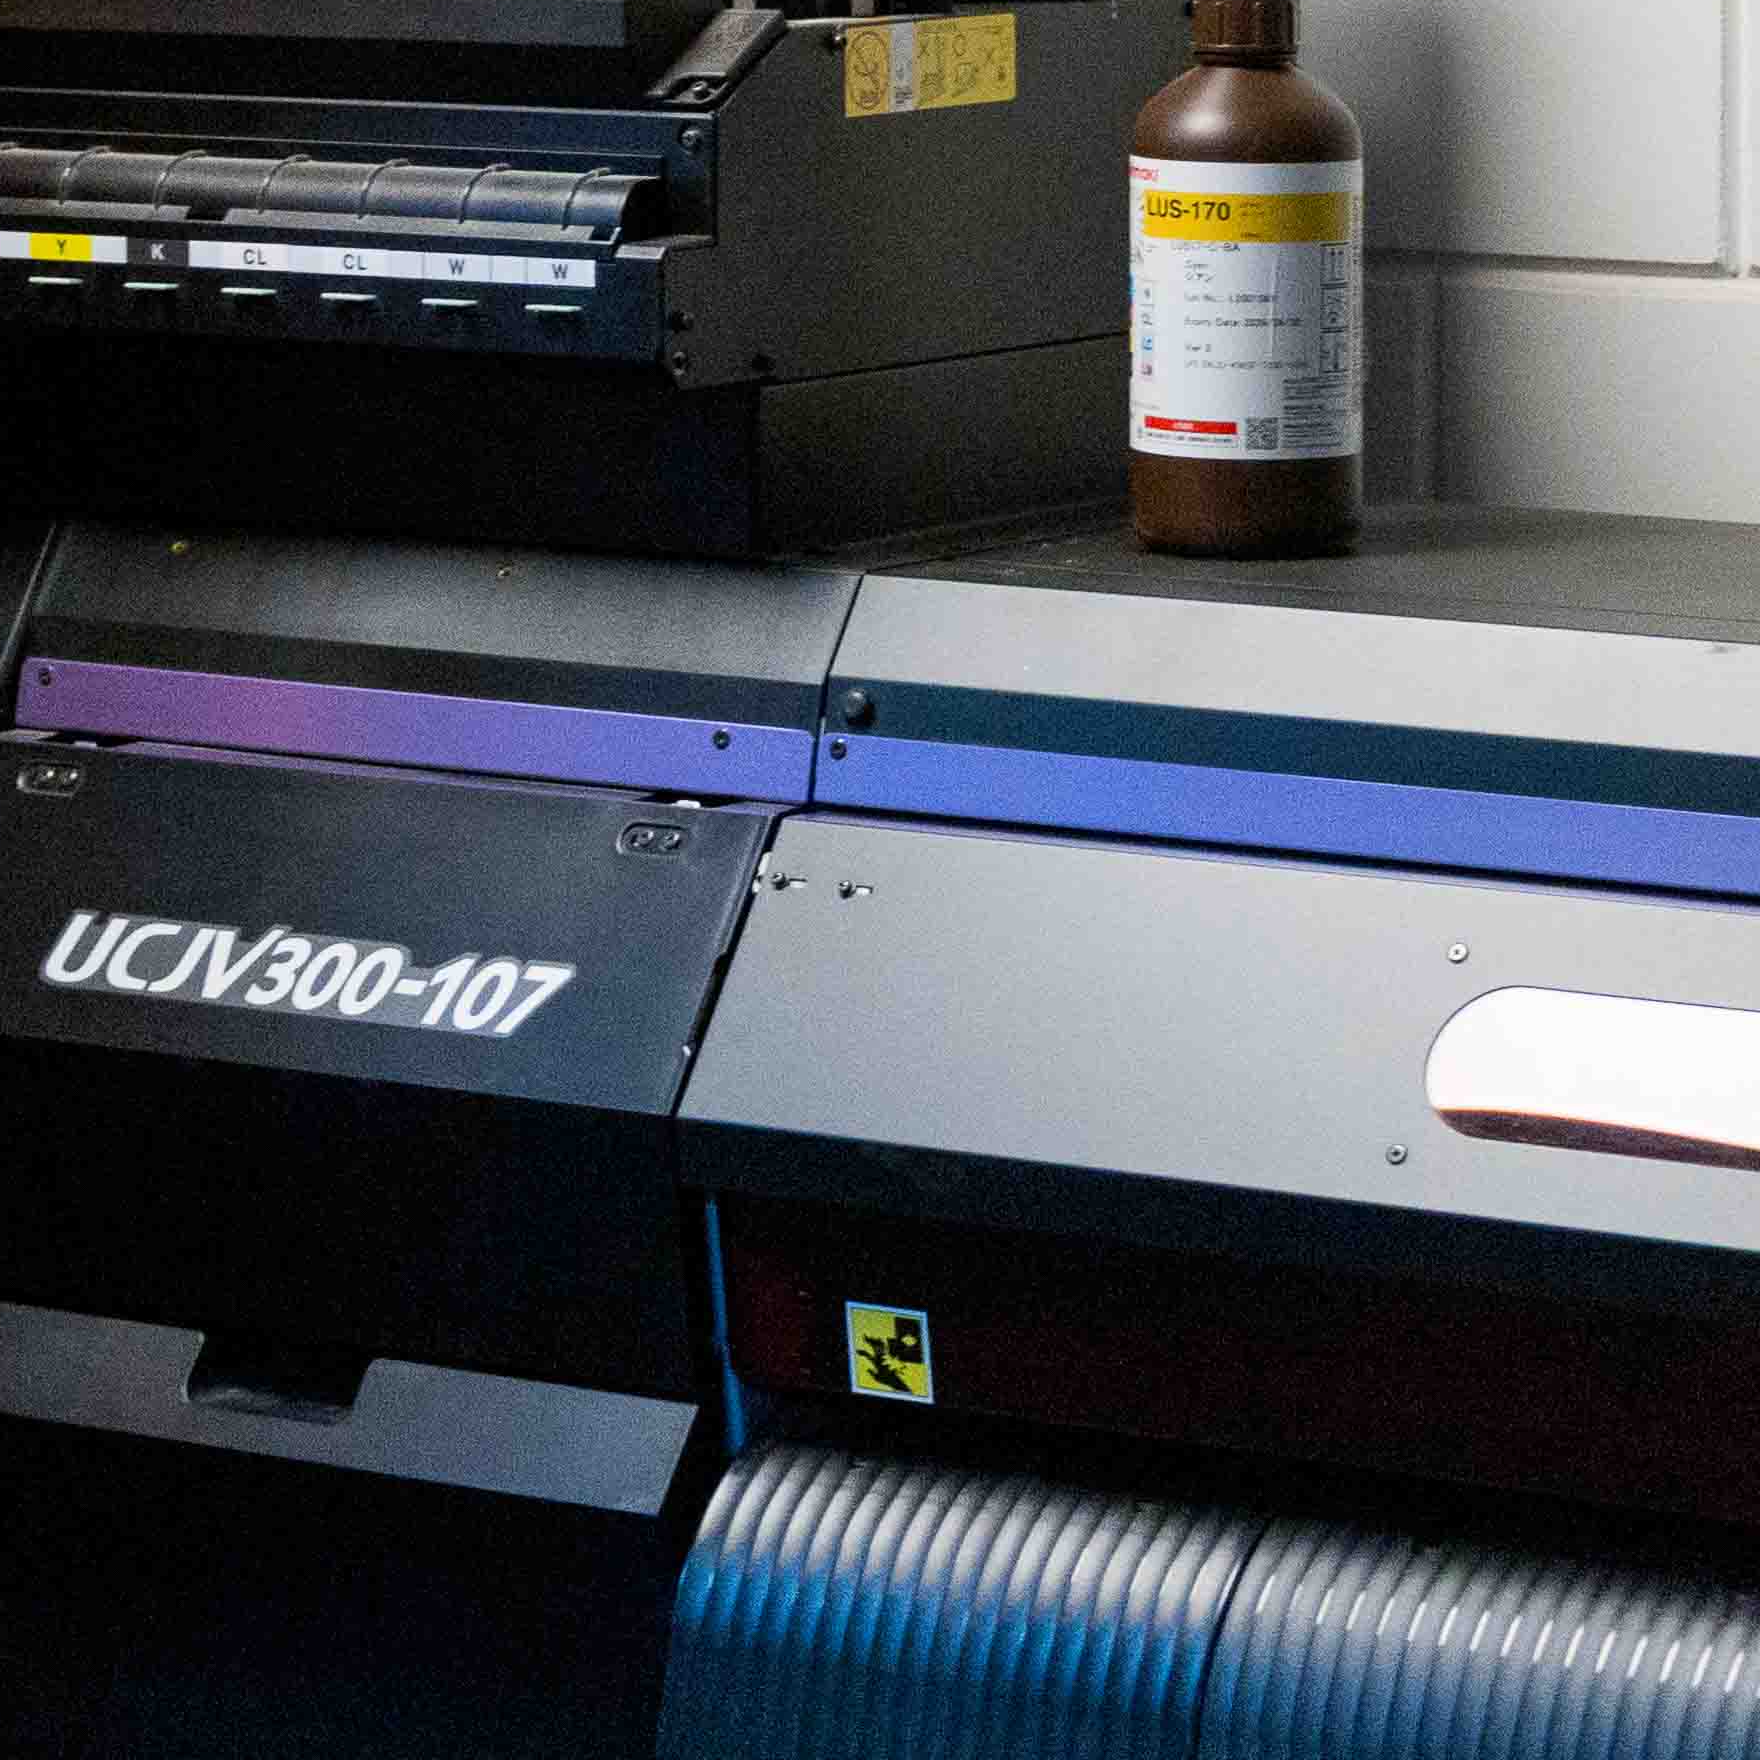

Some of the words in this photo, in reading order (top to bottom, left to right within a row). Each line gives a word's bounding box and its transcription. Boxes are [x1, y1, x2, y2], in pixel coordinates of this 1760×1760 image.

[1146, 197, 1231, 221] LUS-170
[55, 239, 67, 255] Y
[150, 243, 165, 260] K
[243, 249, 267, 266] CL
[343, 254, 368, 271] CL
[448, 258, 465, 275] W
[551, 263, 568, 279] W
[44, 913, 574, 1034] UCJV300-107
